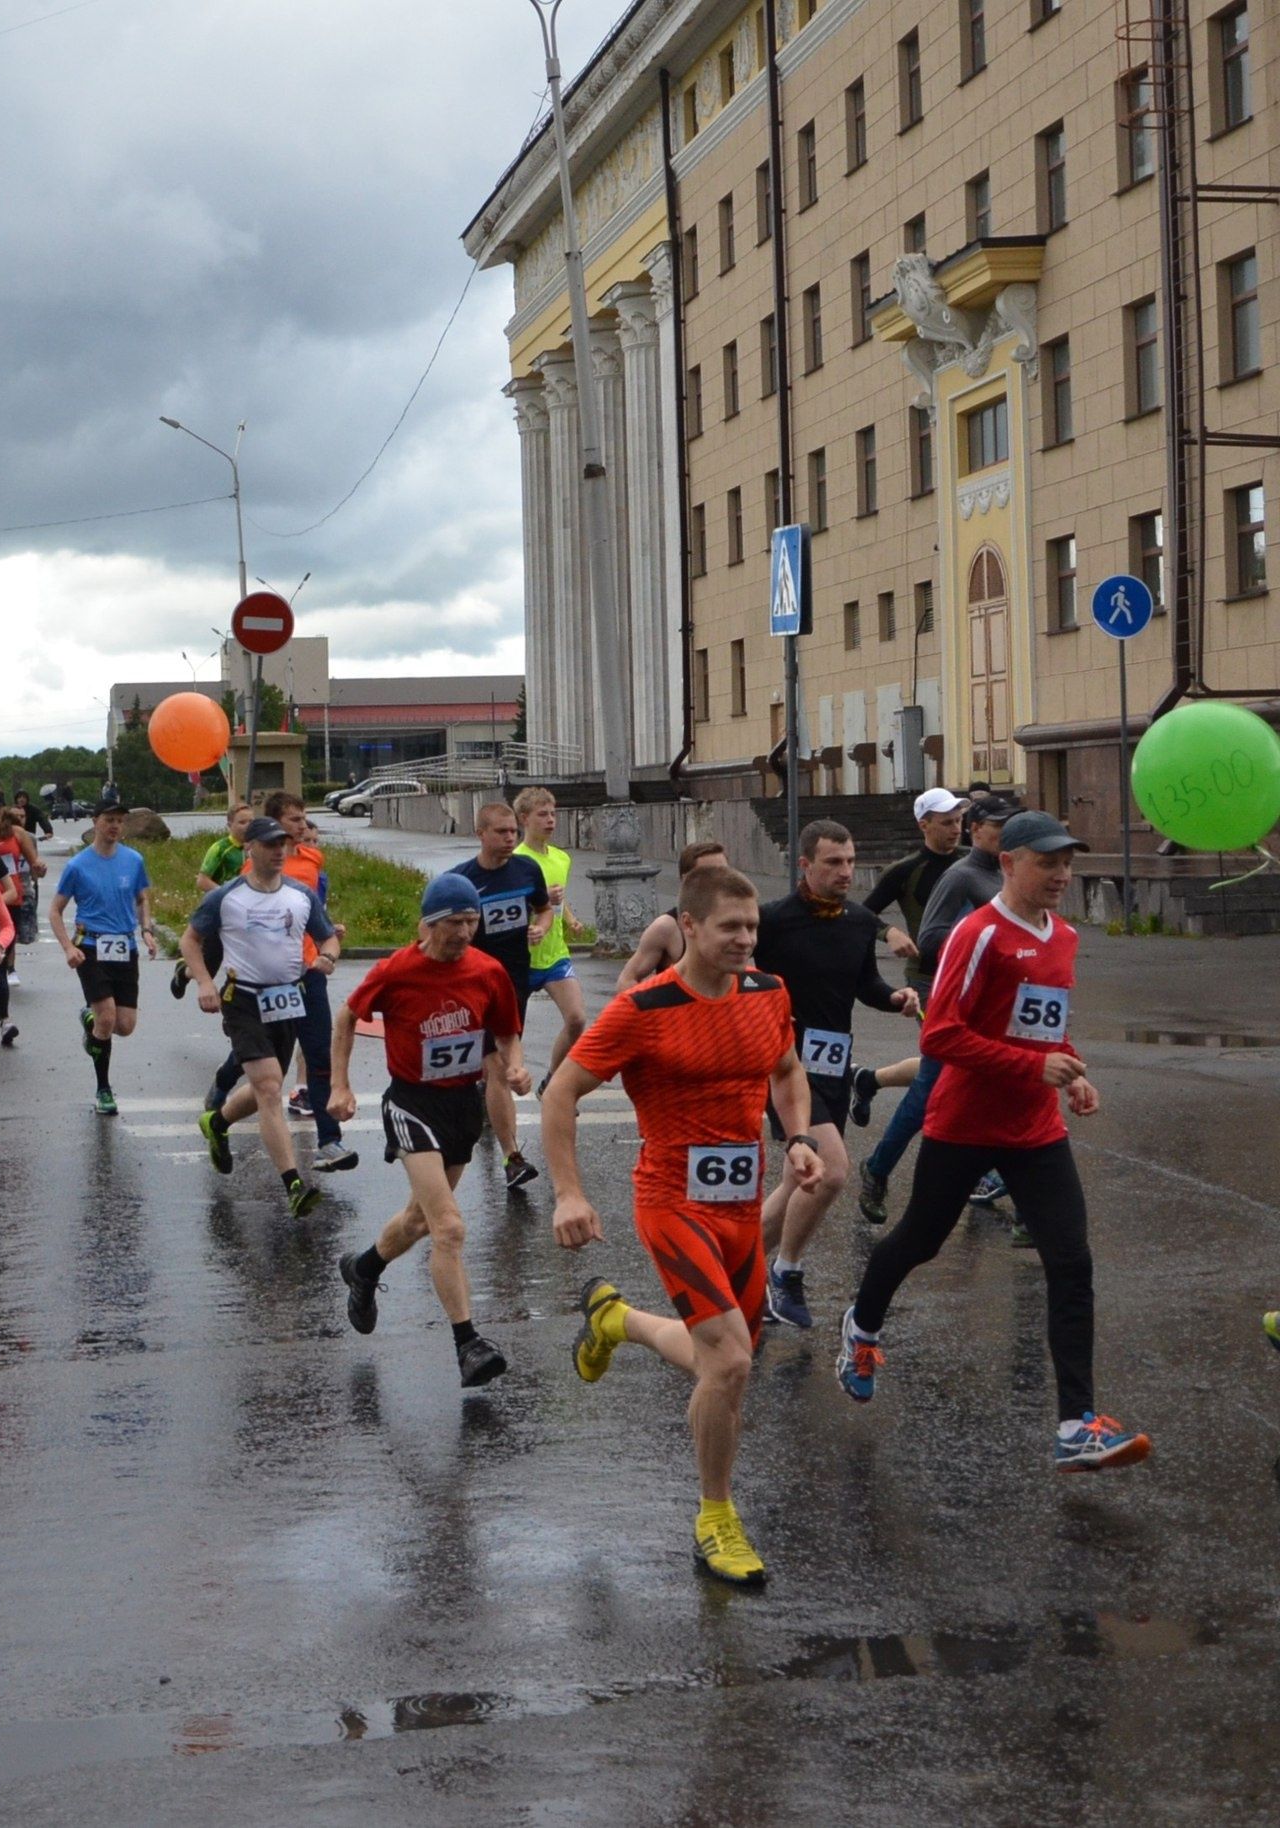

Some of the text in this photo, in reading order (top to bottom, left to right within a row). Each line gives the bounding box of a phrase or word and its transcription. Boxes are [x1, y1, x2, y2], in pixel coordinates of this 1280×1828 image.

[488, 904, 523, 926] 29
[101, 940, 127, 954] 73
[261, 991, 301, 1013] 105
[1018, 997, 1062, 1028] 58
[429, 1040, 475, 1069] 57
[810, 1039, 845, 1065] 78
[696, 1155, 754, 1186] 68
